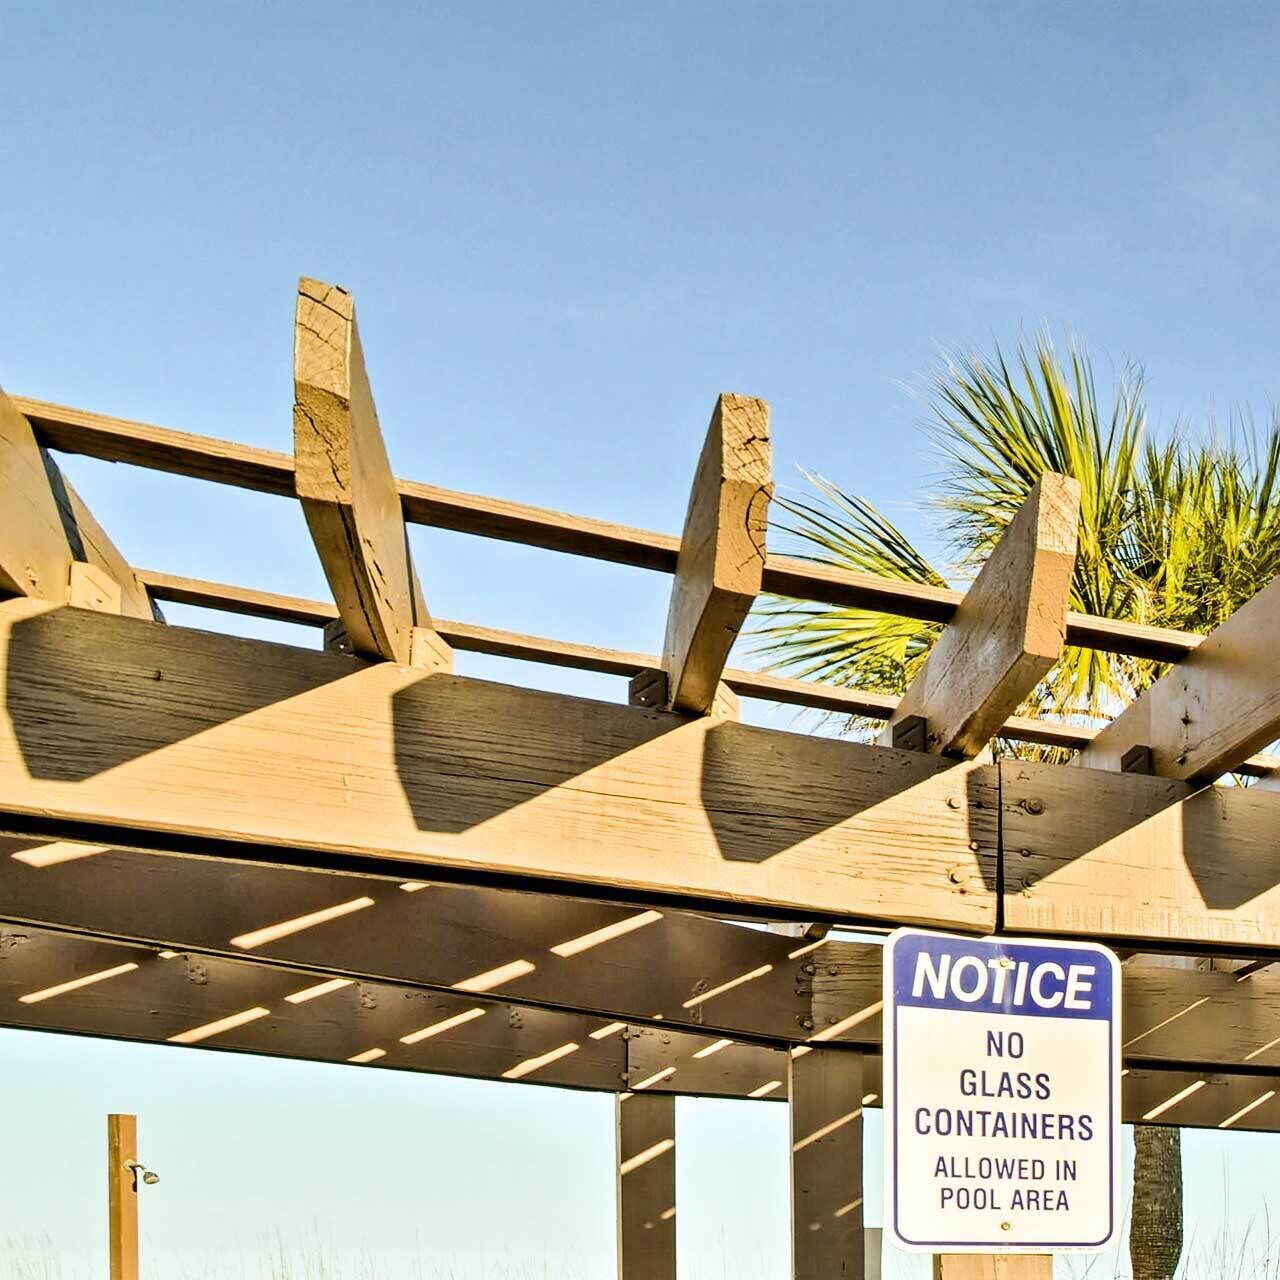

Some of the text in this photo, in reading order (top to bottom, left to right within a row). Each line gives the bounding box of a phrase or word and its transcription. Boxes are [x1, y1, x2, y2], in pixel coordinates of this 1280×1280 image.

[912, 952, 1096, 1010] NOTICE
[987, 1030, 1024, 1059] NO
[960, 1069, 1051, 1100] GLASS
[915, 1108, 1094, 1141] CONTAINERS
[934, 1156, 1077, 1181] ALLOWED IN
[940, 1188, 1069, 1211] POOL AREA
